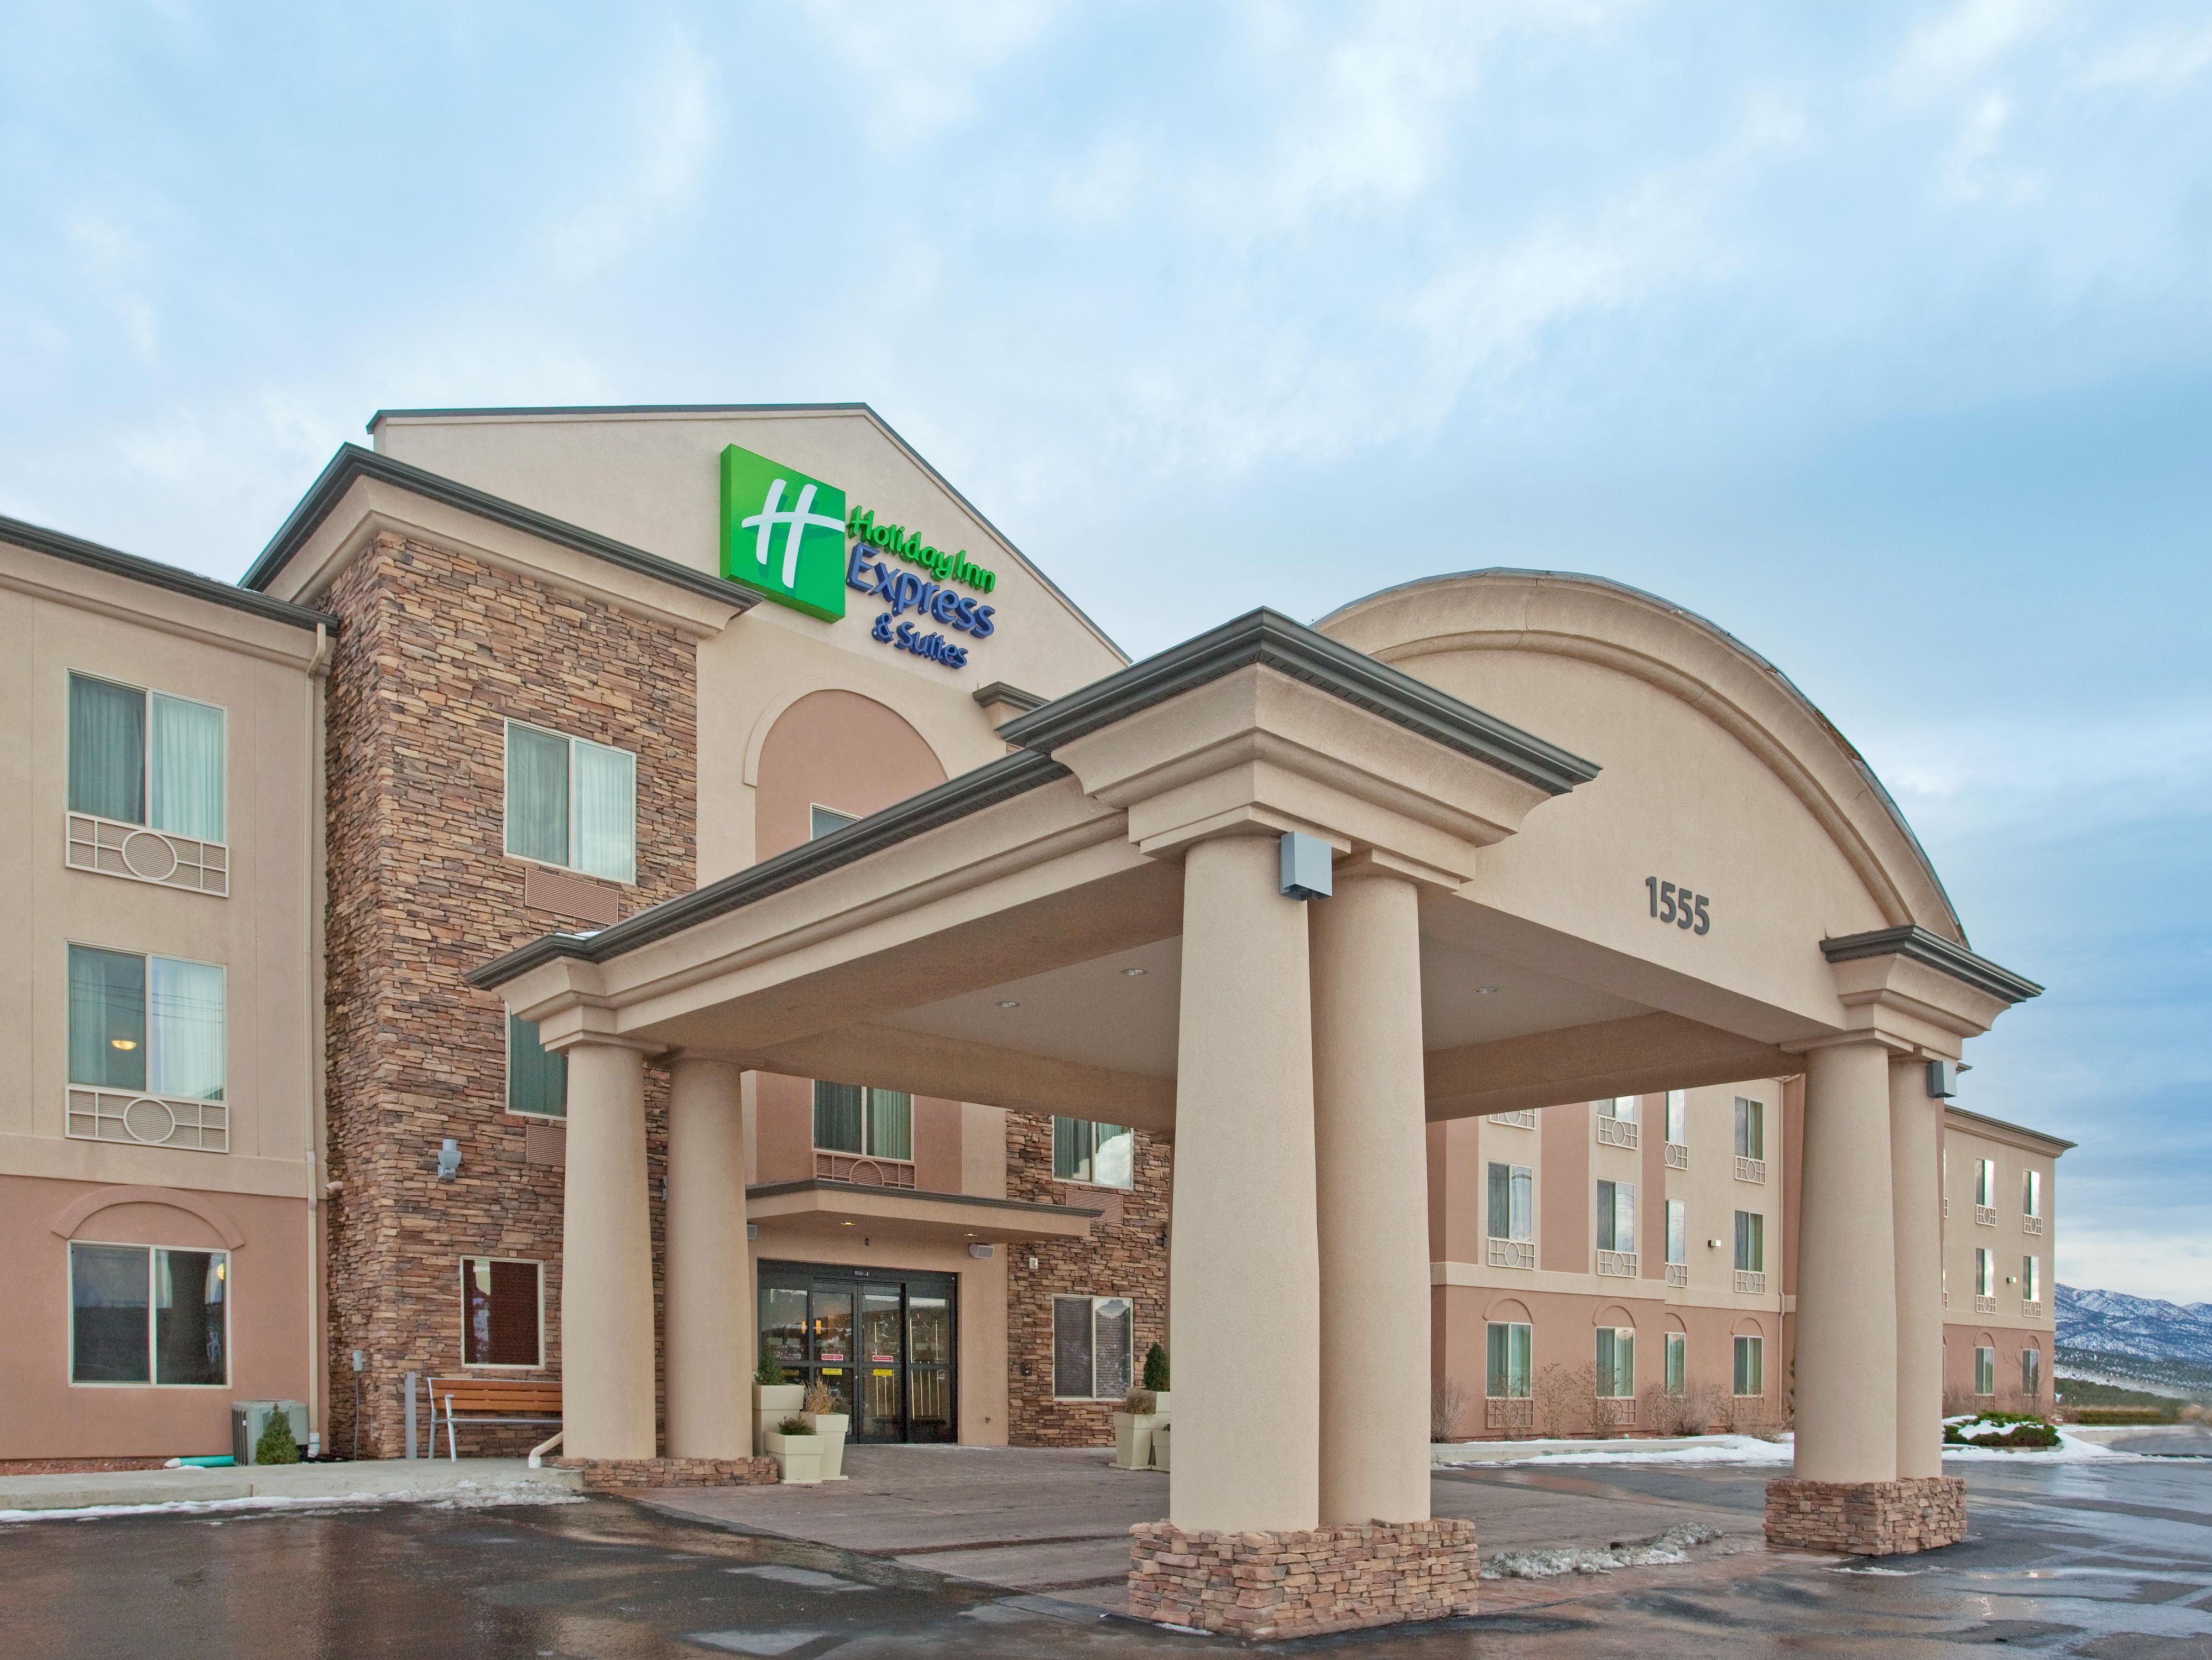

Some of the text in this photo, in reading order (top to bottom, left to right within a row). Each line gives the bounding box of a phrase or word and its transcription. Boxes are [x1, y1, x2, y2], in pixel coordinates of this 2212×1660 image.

[846, 506, 995, 594] Holiday Inn
[846, 543, 995, 639] Express
[872, 612, 968, 669] & Suites
[1646, 876, 1710, 935] 1555
